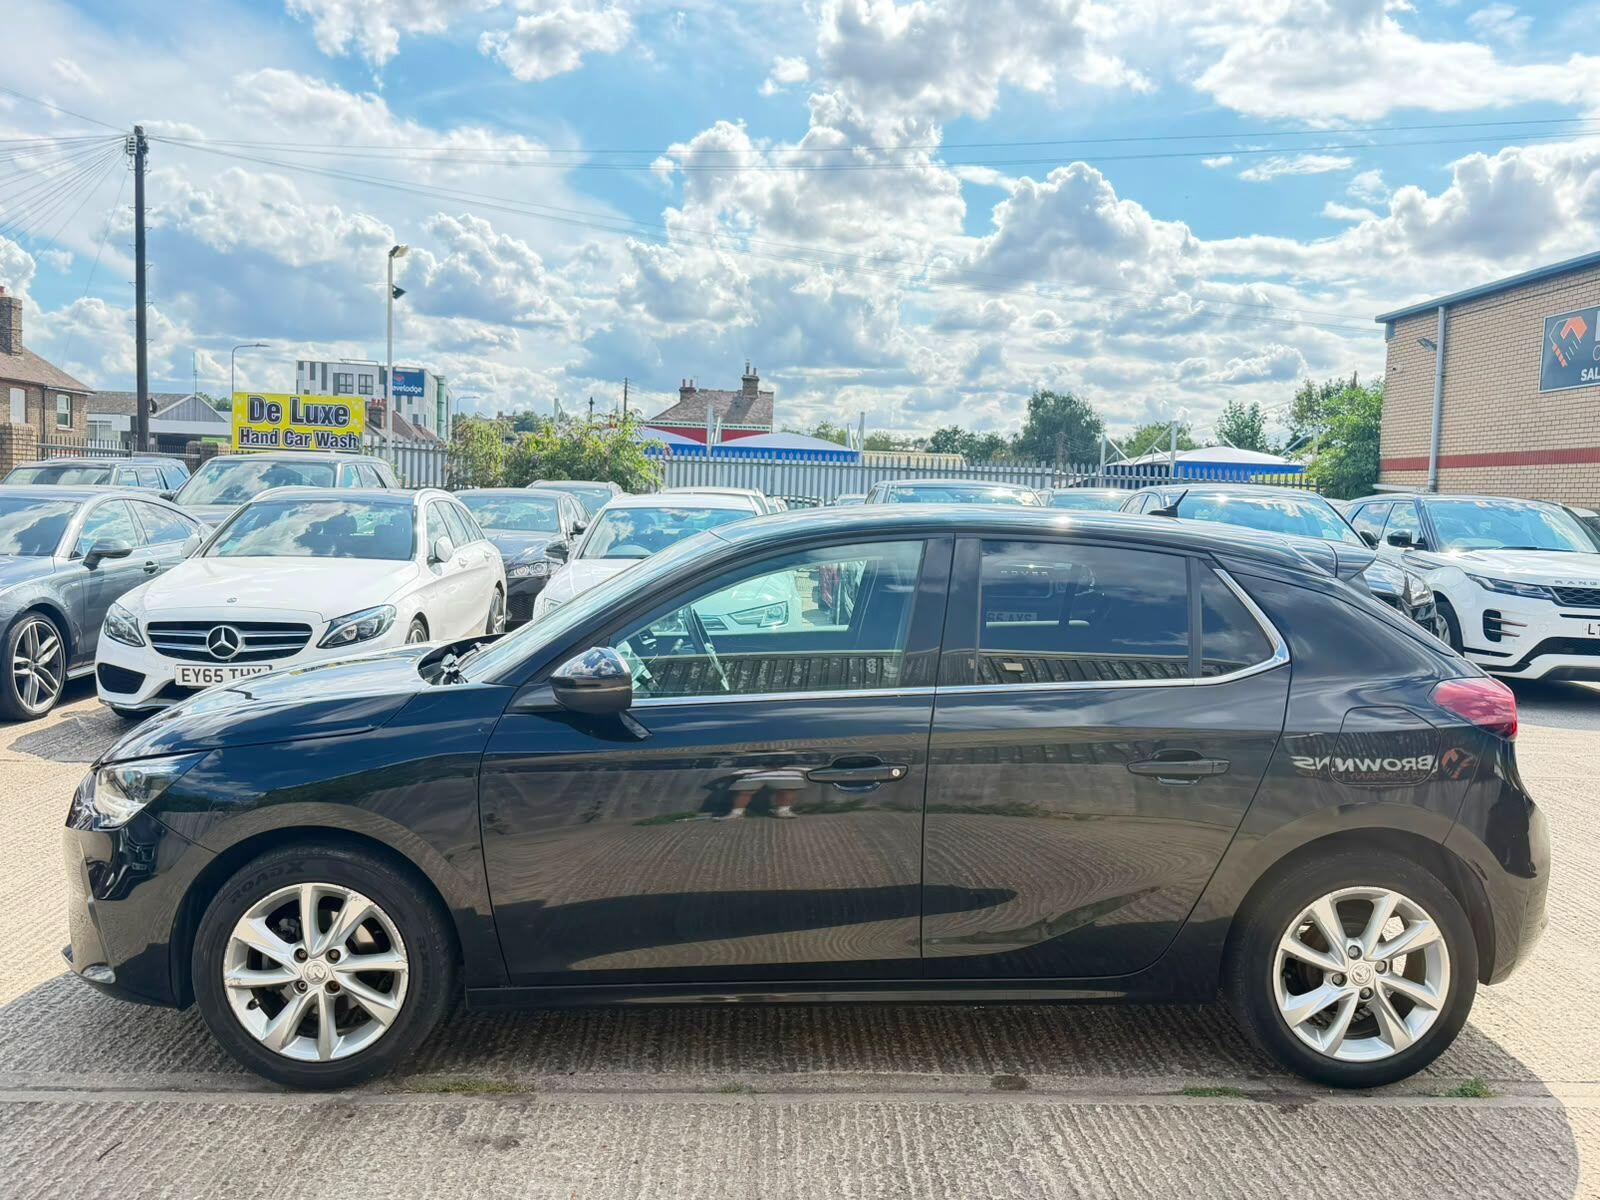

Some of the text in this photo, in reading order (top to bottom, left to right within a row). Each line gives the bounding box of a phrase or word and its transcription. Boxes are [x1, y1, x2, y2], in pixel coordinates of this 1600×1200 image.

[248, 395, 350, 427] De Luxe
[239, 427, 359, 449] Hand Car Wash
[181, 668, 223, 683] EY65
